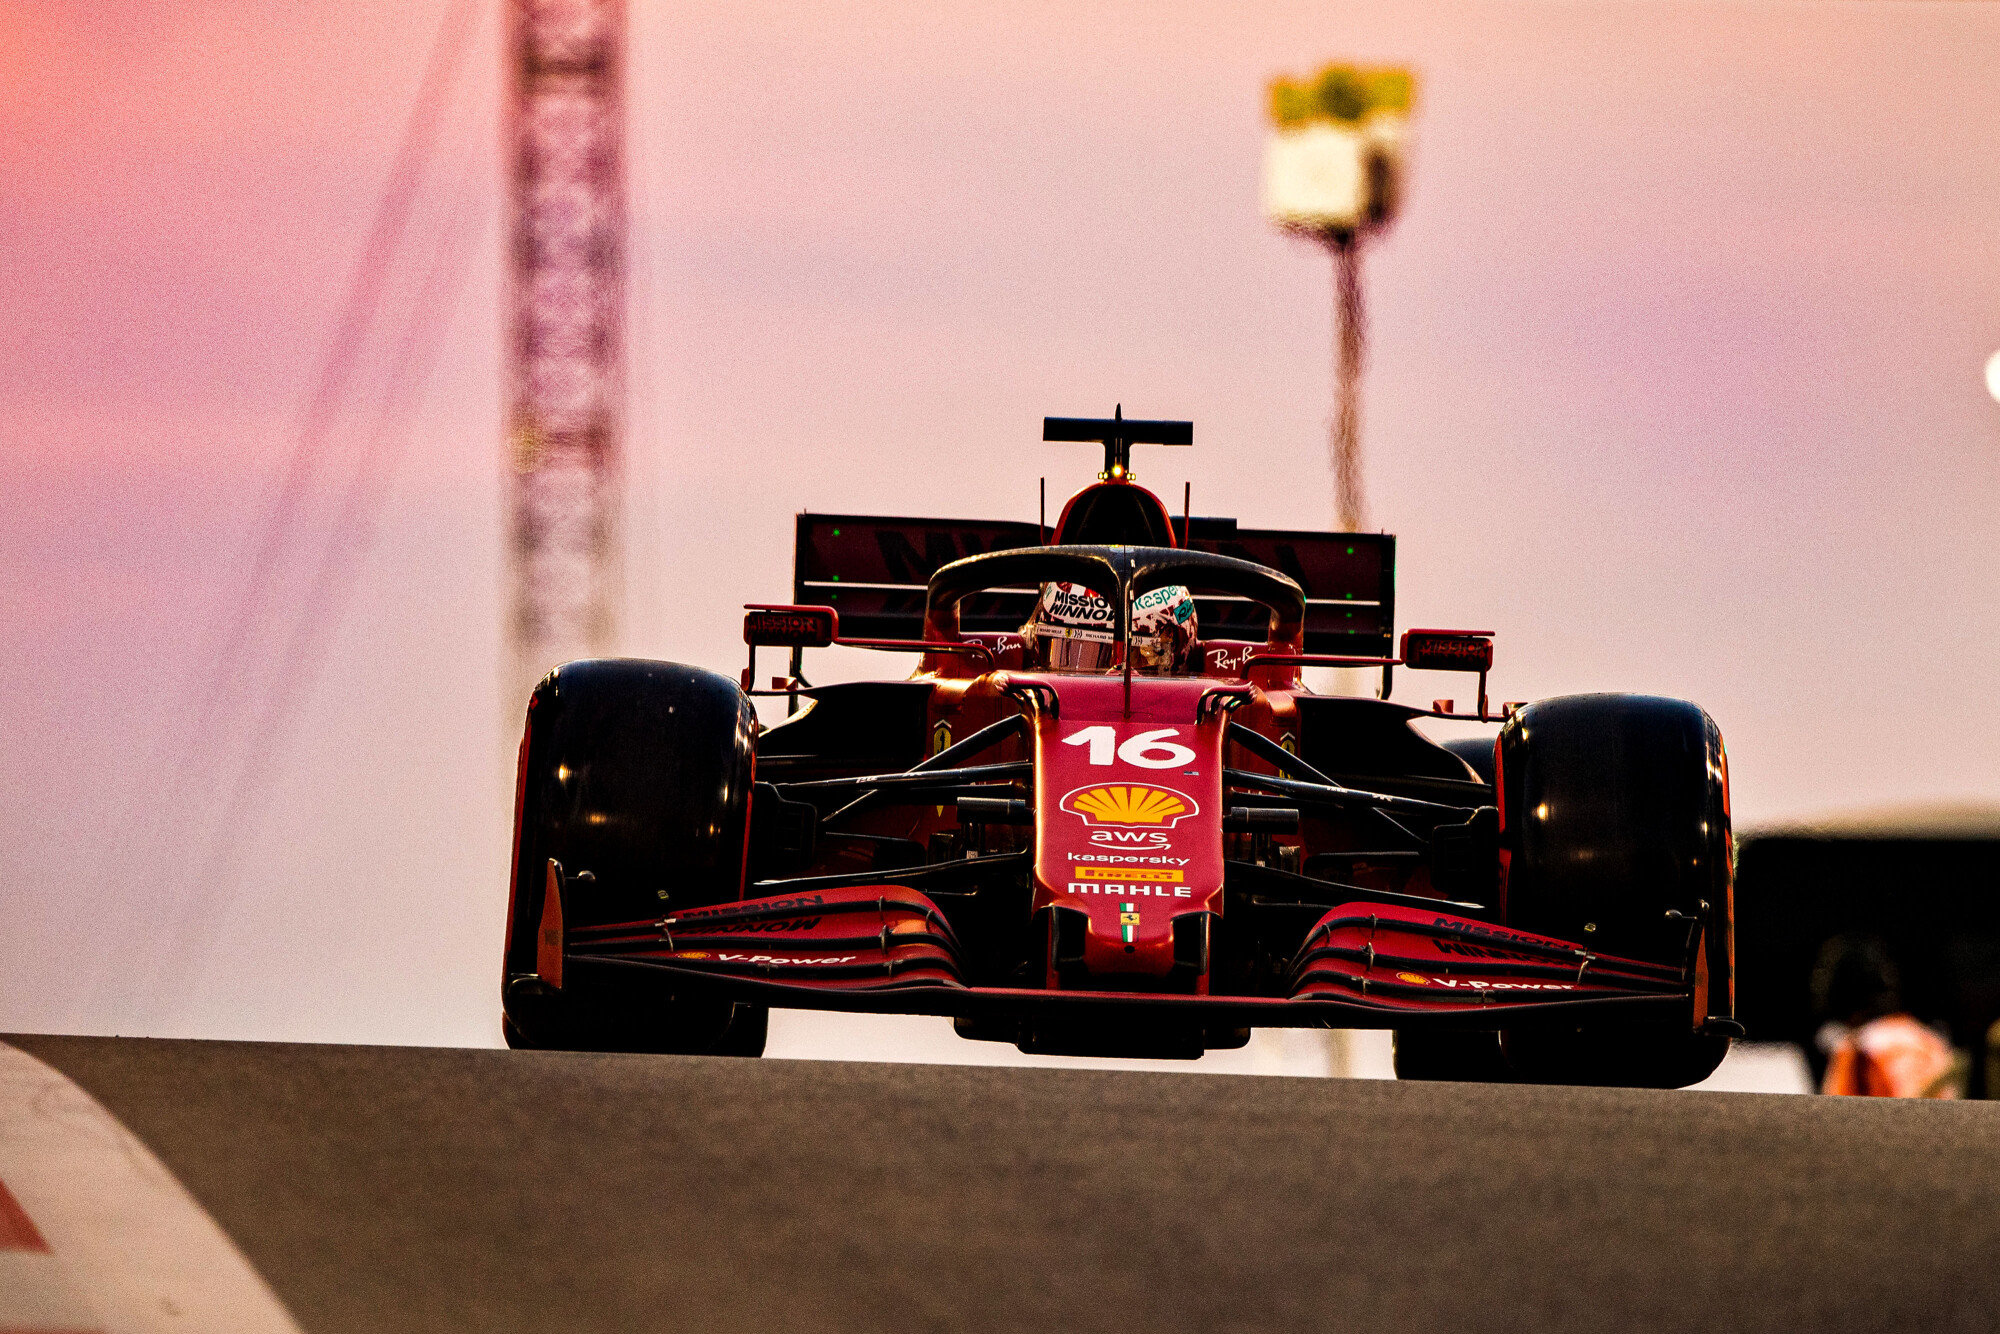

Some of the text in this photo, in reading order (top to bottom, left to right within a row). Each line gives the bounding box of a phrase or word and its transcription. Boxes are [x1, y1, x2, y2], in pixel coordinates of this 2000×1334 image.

[1054, 591, 1108, 609] MISSIO
[1134, 585, 1178, 611] kaspe
[1206, 646, 1254, 670] Ray-B
[1061, 725, 1197, 769] 16
[1091, 830, 1168, 844] aws
[1068, 852, 1190, 866] kaspersky
[1068, 882, 1192, 898] MAHLE
[718, 953, 857, 966] V-Power
[1432, 977, 1575, 990] V-Power
